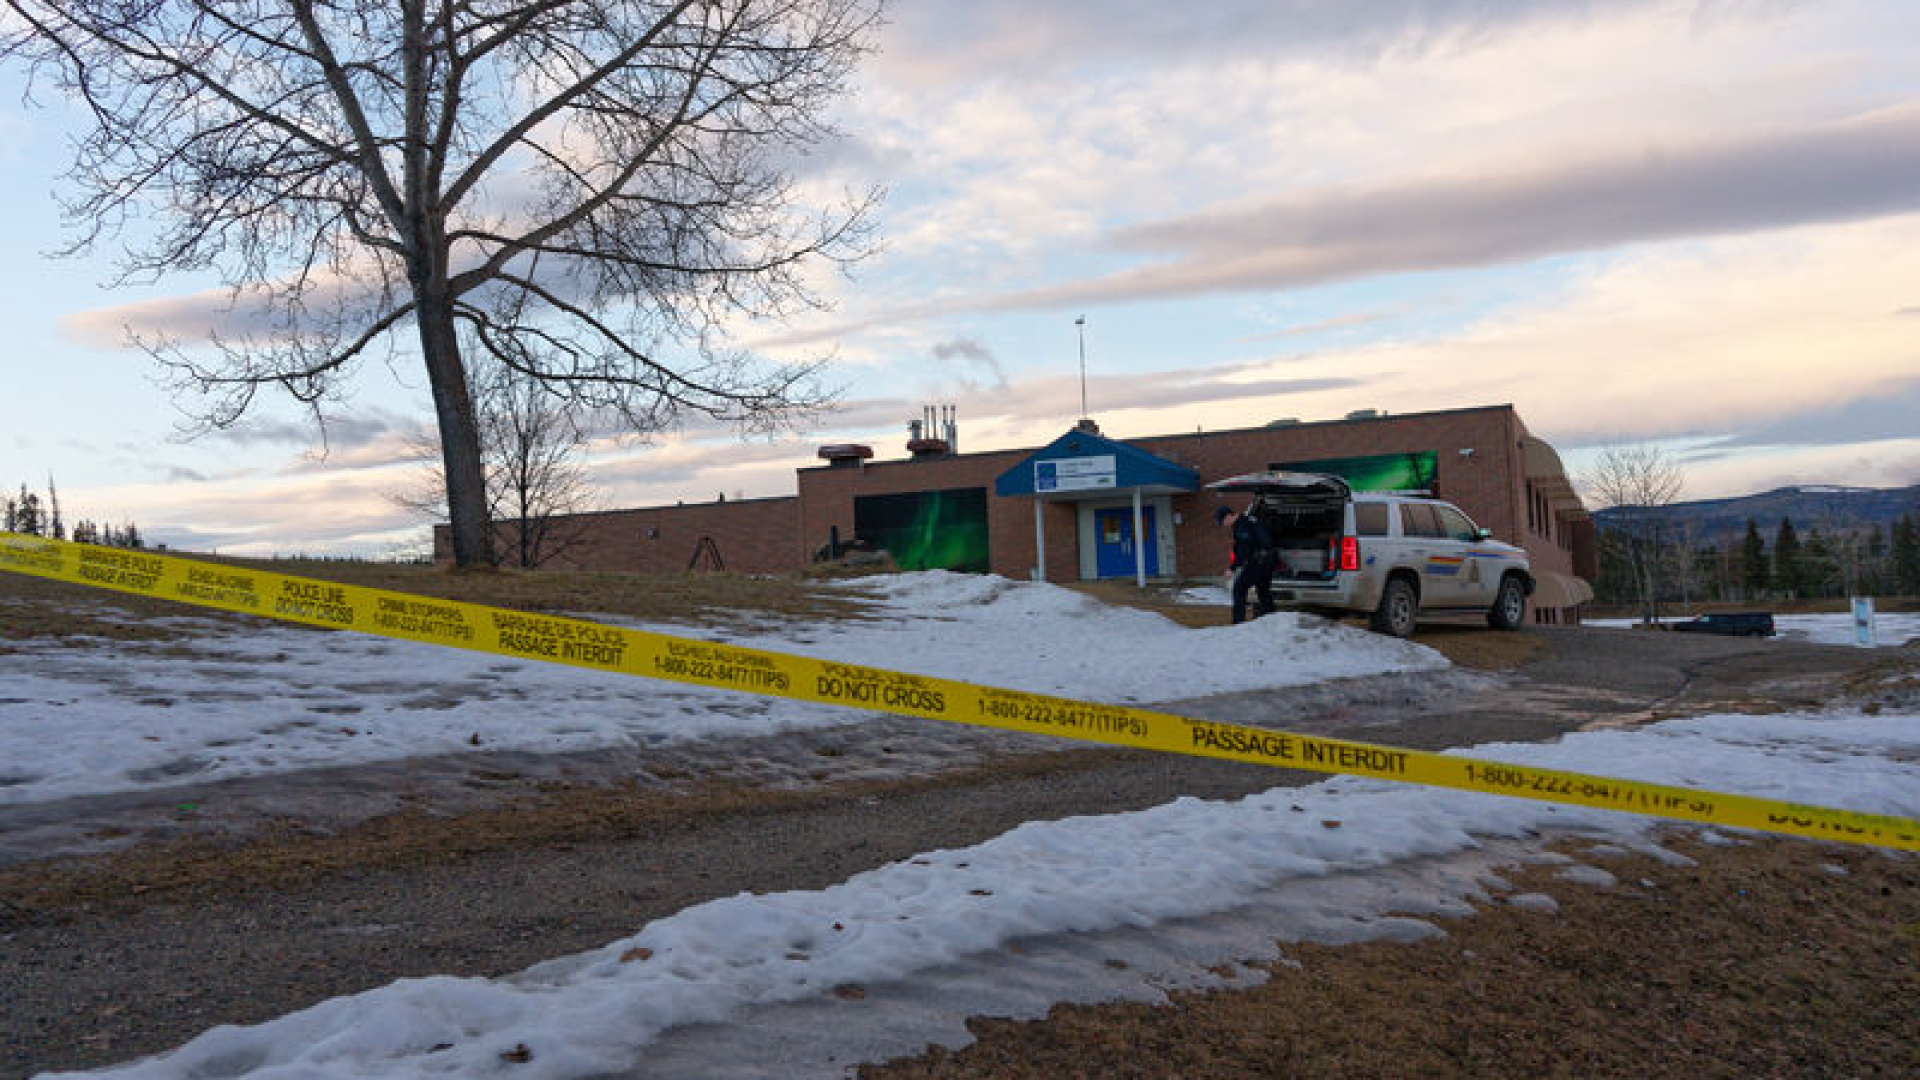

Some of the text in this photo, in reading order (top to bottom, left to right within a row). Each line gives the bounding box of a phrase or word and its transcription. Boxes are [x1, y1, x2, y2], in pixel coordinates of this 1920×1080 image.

[282, 580, 319, 600] POLICE
[317, 602, 354, 625] CROSS
[499, 631, 623, 667] PASSAGE INTERDIT
[817, 677, 946, 712] DO NOT CROSS
[1192, 726, 1408, 775] PASSAGE INTERDIT
